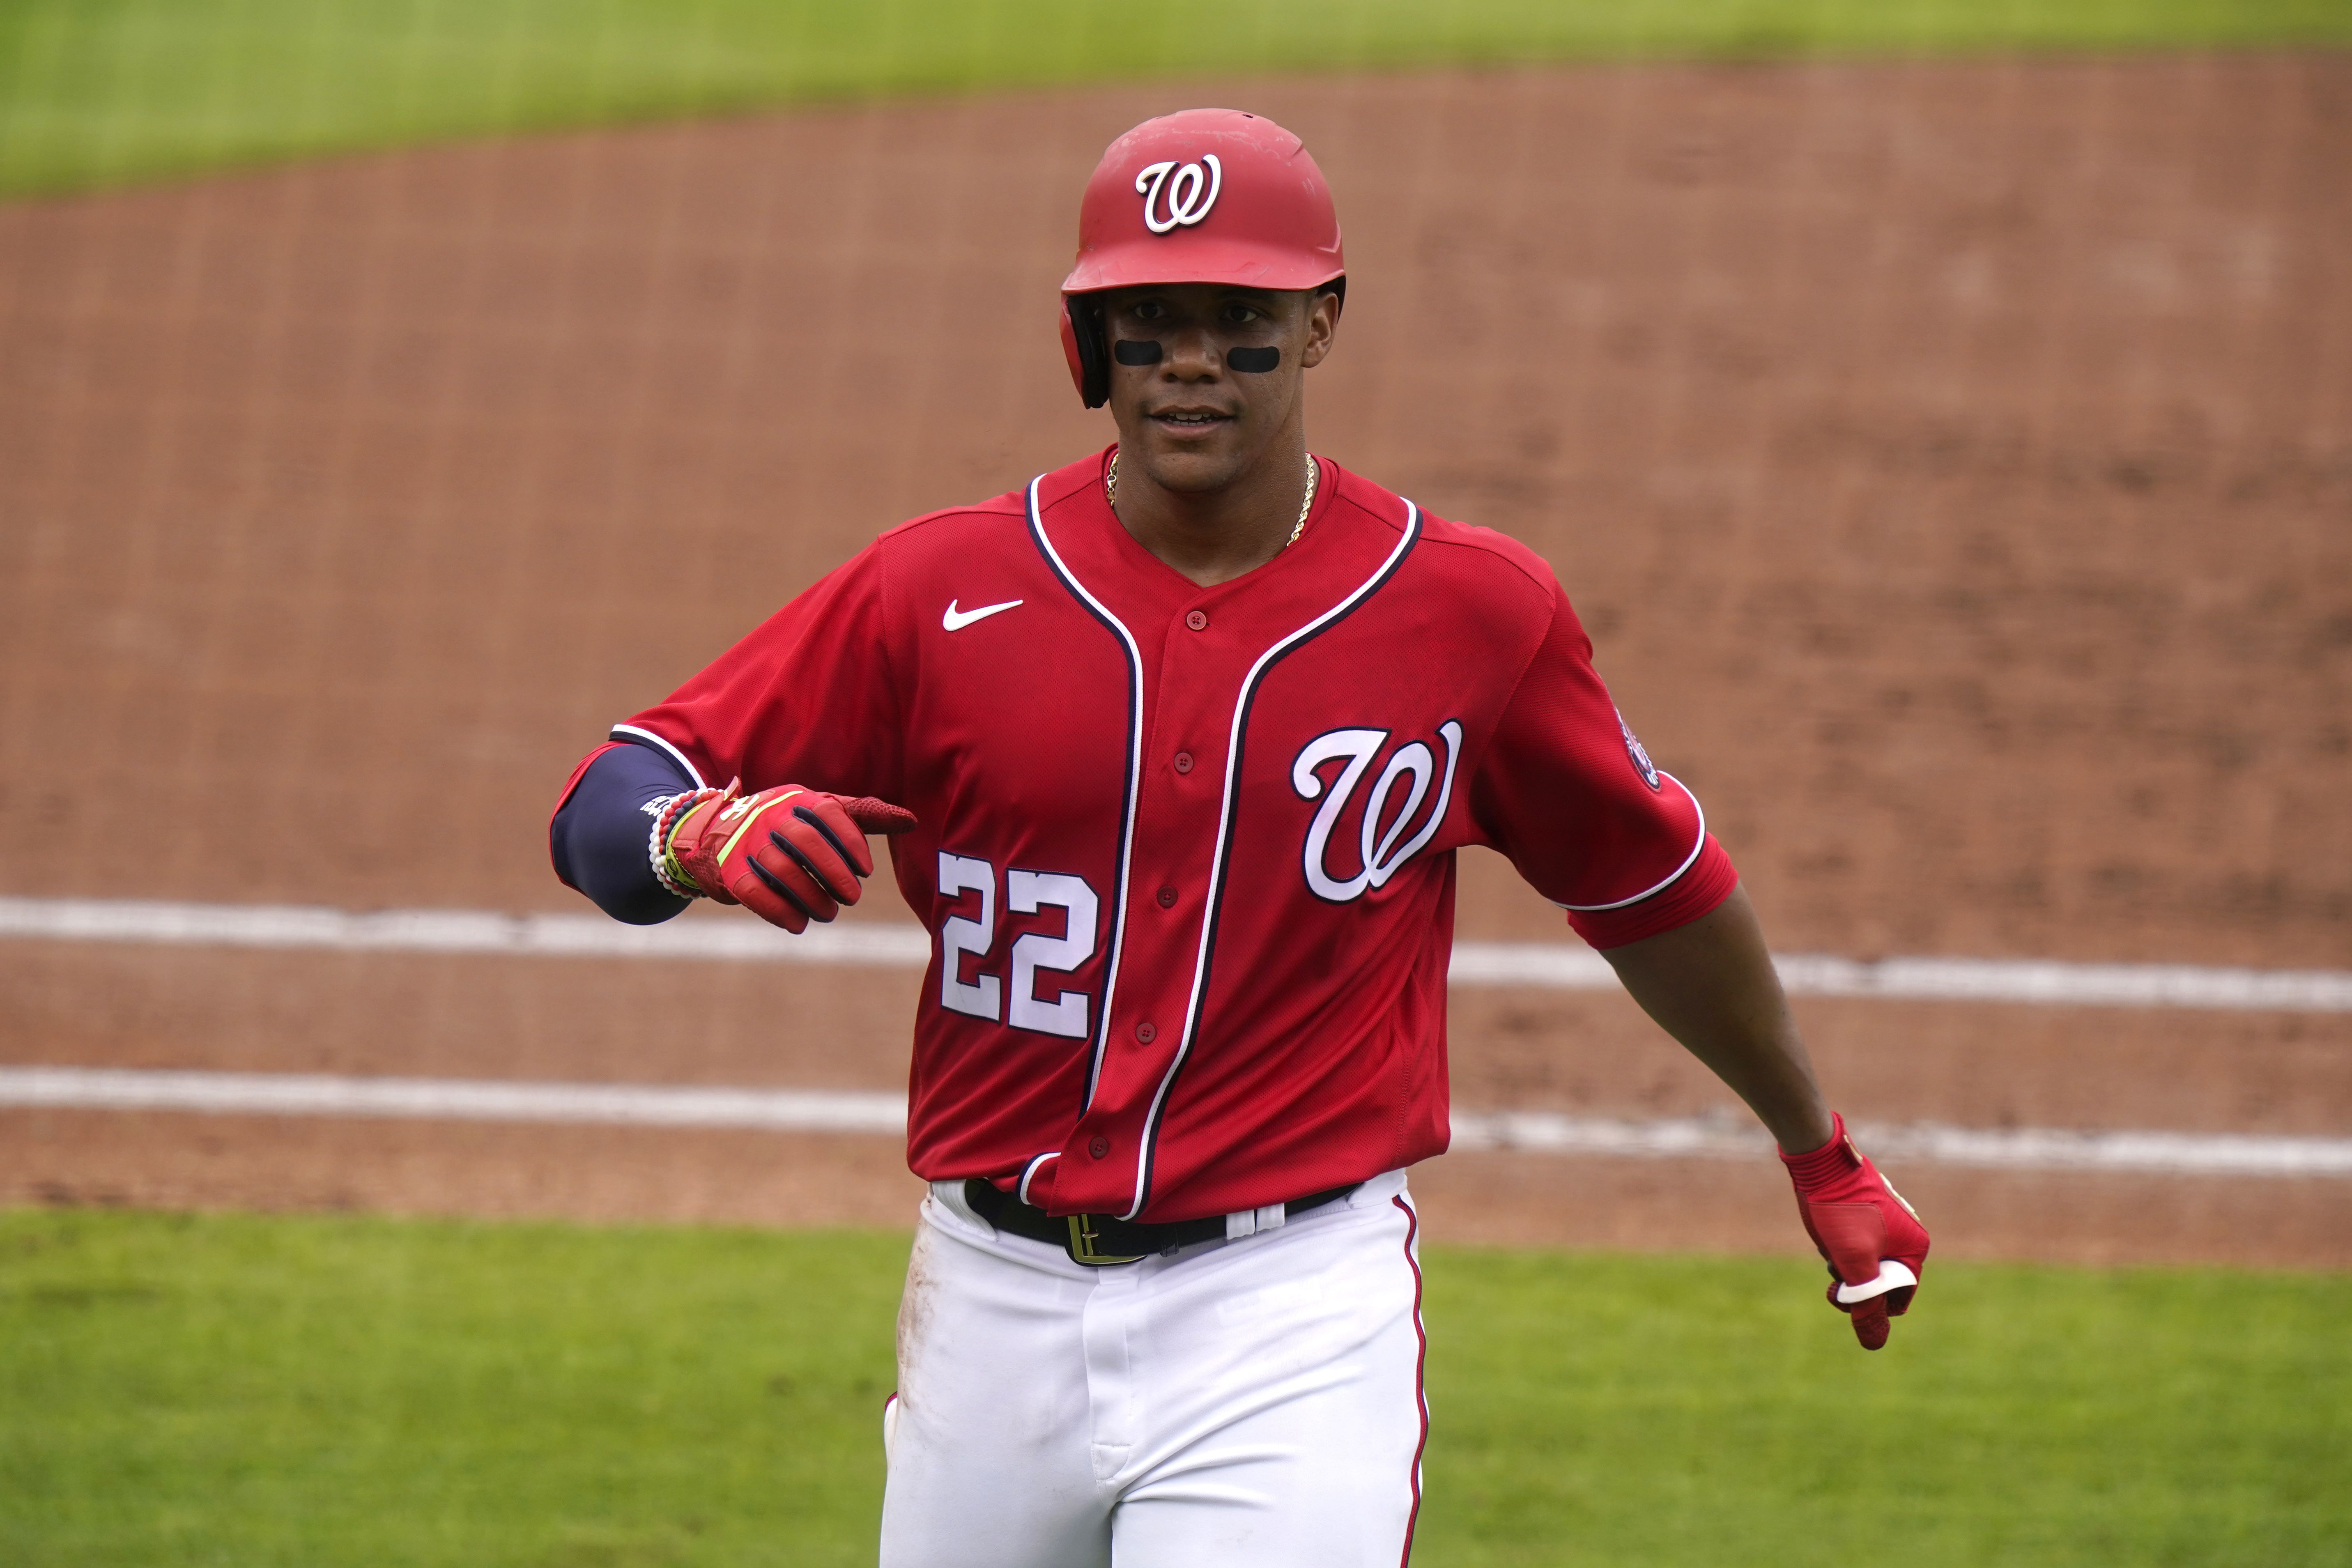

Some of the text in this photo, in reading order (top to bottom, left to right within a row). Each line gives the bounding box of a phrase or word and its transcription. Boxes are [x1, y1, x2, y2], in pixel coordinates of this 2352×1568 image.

[1135, 153, 1223, 235] W
[1289, 717, 1465, 905] W
[938, 848, 1101, 1041] 22
